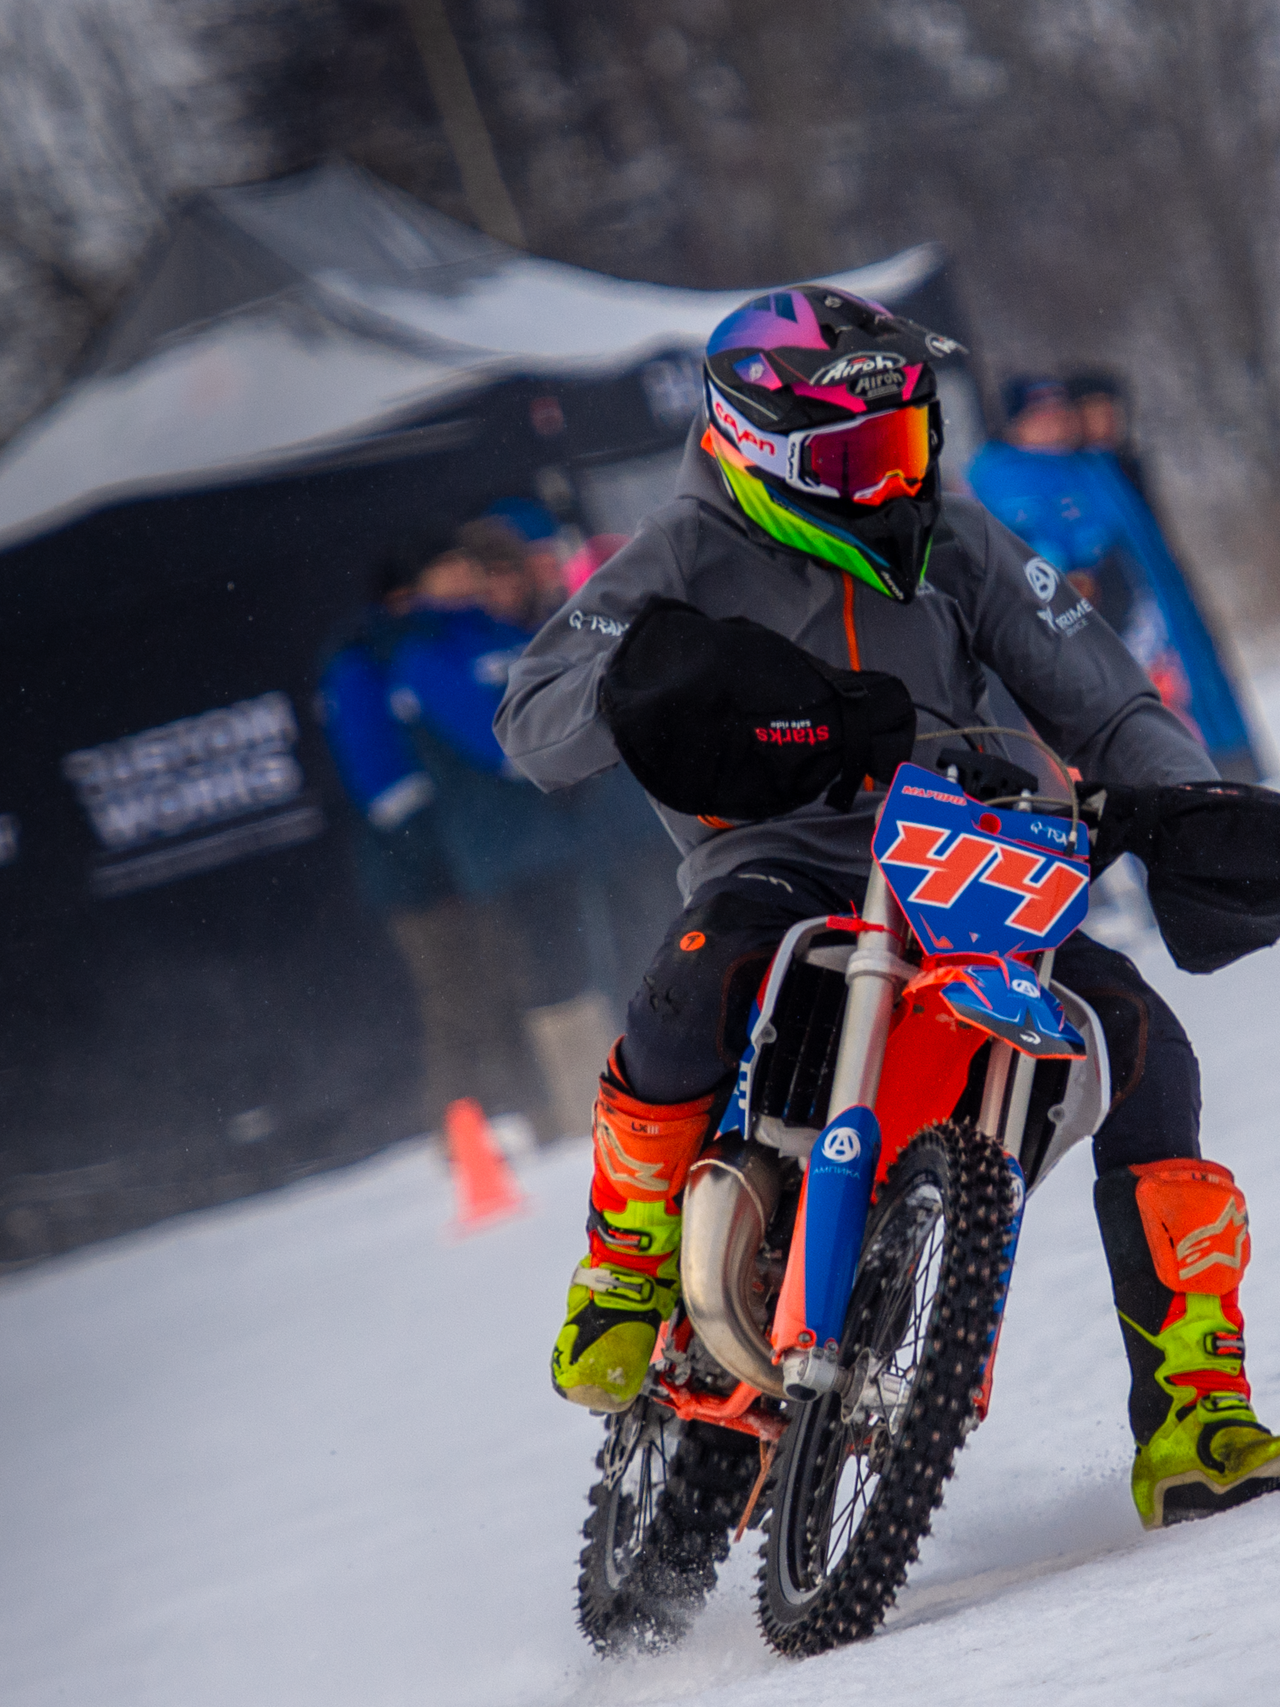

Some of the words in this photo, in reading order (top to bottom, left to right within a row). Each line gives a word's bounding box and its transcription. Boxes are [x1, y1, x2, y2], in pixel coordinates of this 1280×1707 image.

[821, 355, 893, 385] Airoh
[855, 371, 902, 394] Airoh
[755, 725, 830, 746] starks
[879, 820, 1090, 938] 44
